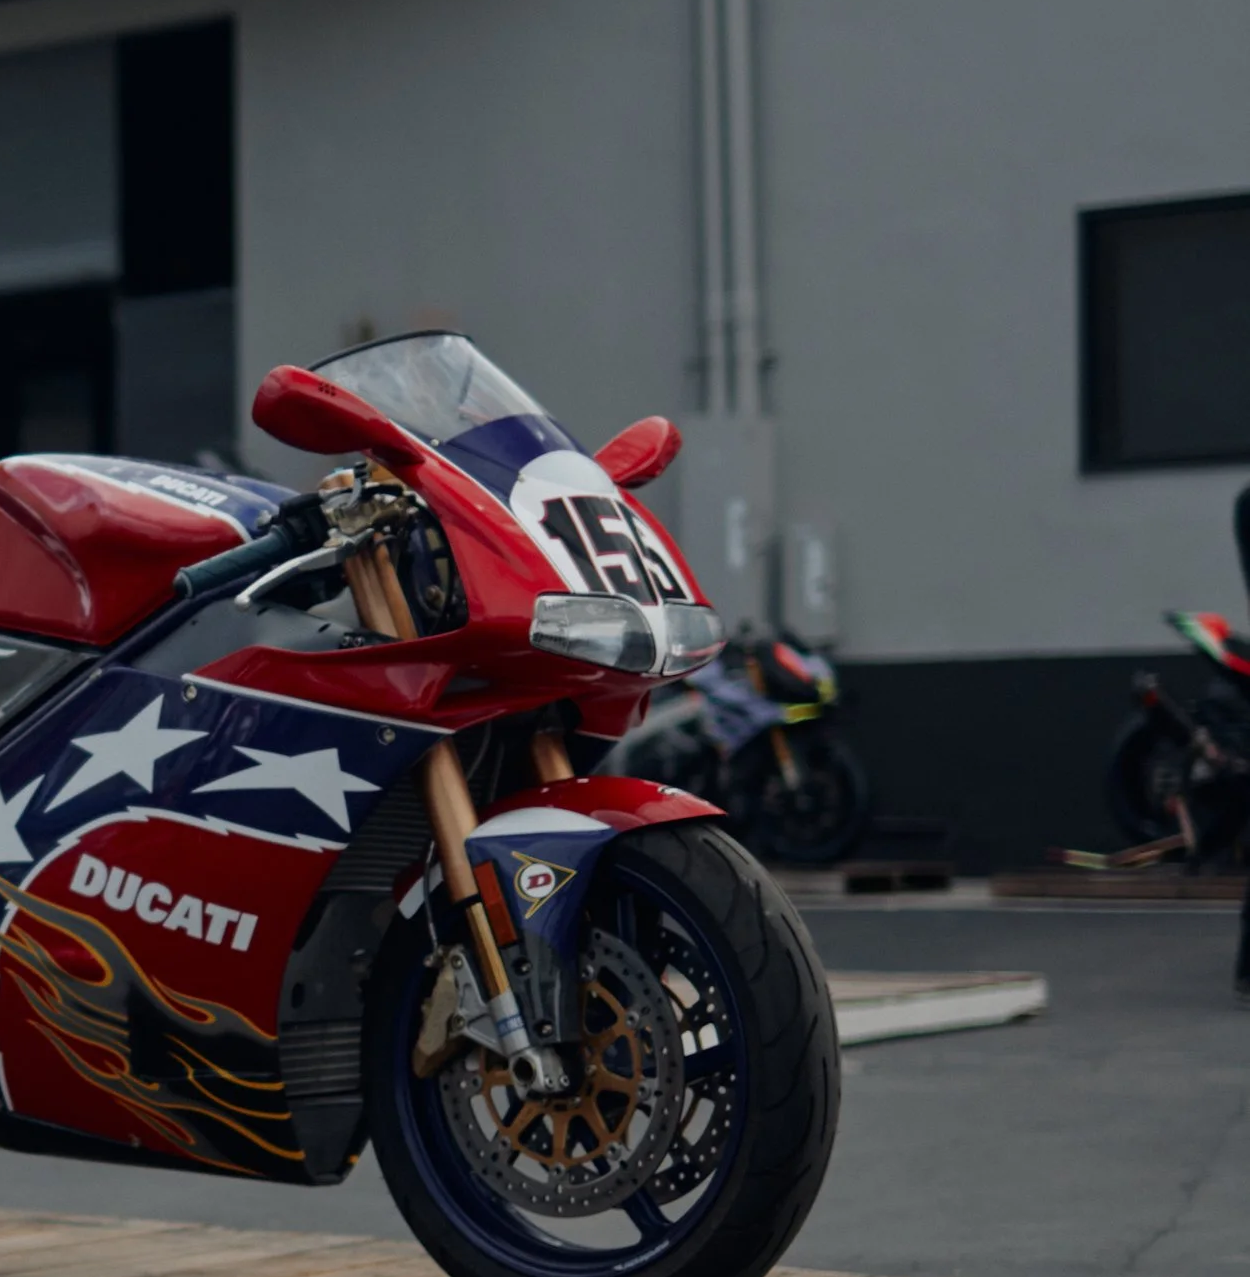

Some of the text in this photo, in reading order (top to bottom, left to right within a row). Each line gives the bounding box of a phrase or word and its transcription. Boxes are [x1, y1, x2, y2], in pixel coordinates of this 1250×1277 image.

[150, 474, 228, 506] DUCATI
[527, 873, 552, 890] D
[69, 853, 258, 952] DUCATI
